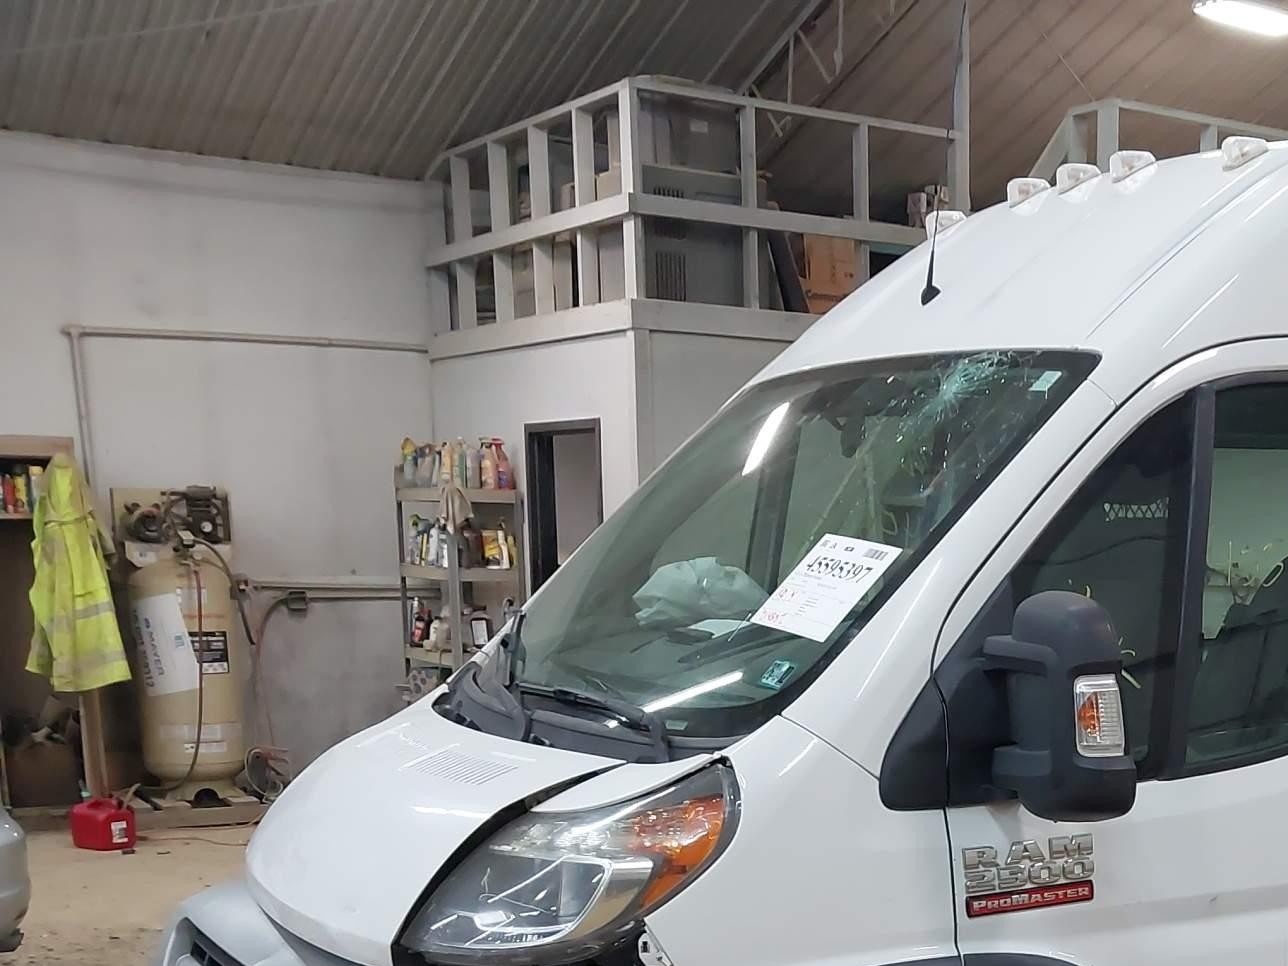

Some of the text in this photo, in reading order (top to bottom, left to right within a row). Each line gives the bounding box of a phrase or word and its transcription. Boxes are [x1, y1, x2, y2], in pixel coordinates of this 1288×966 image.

[806, 555, 874, 584] 45595397
[962, 832, 1094, 870] RAM
[965, 857, 1095, 894] 2500
